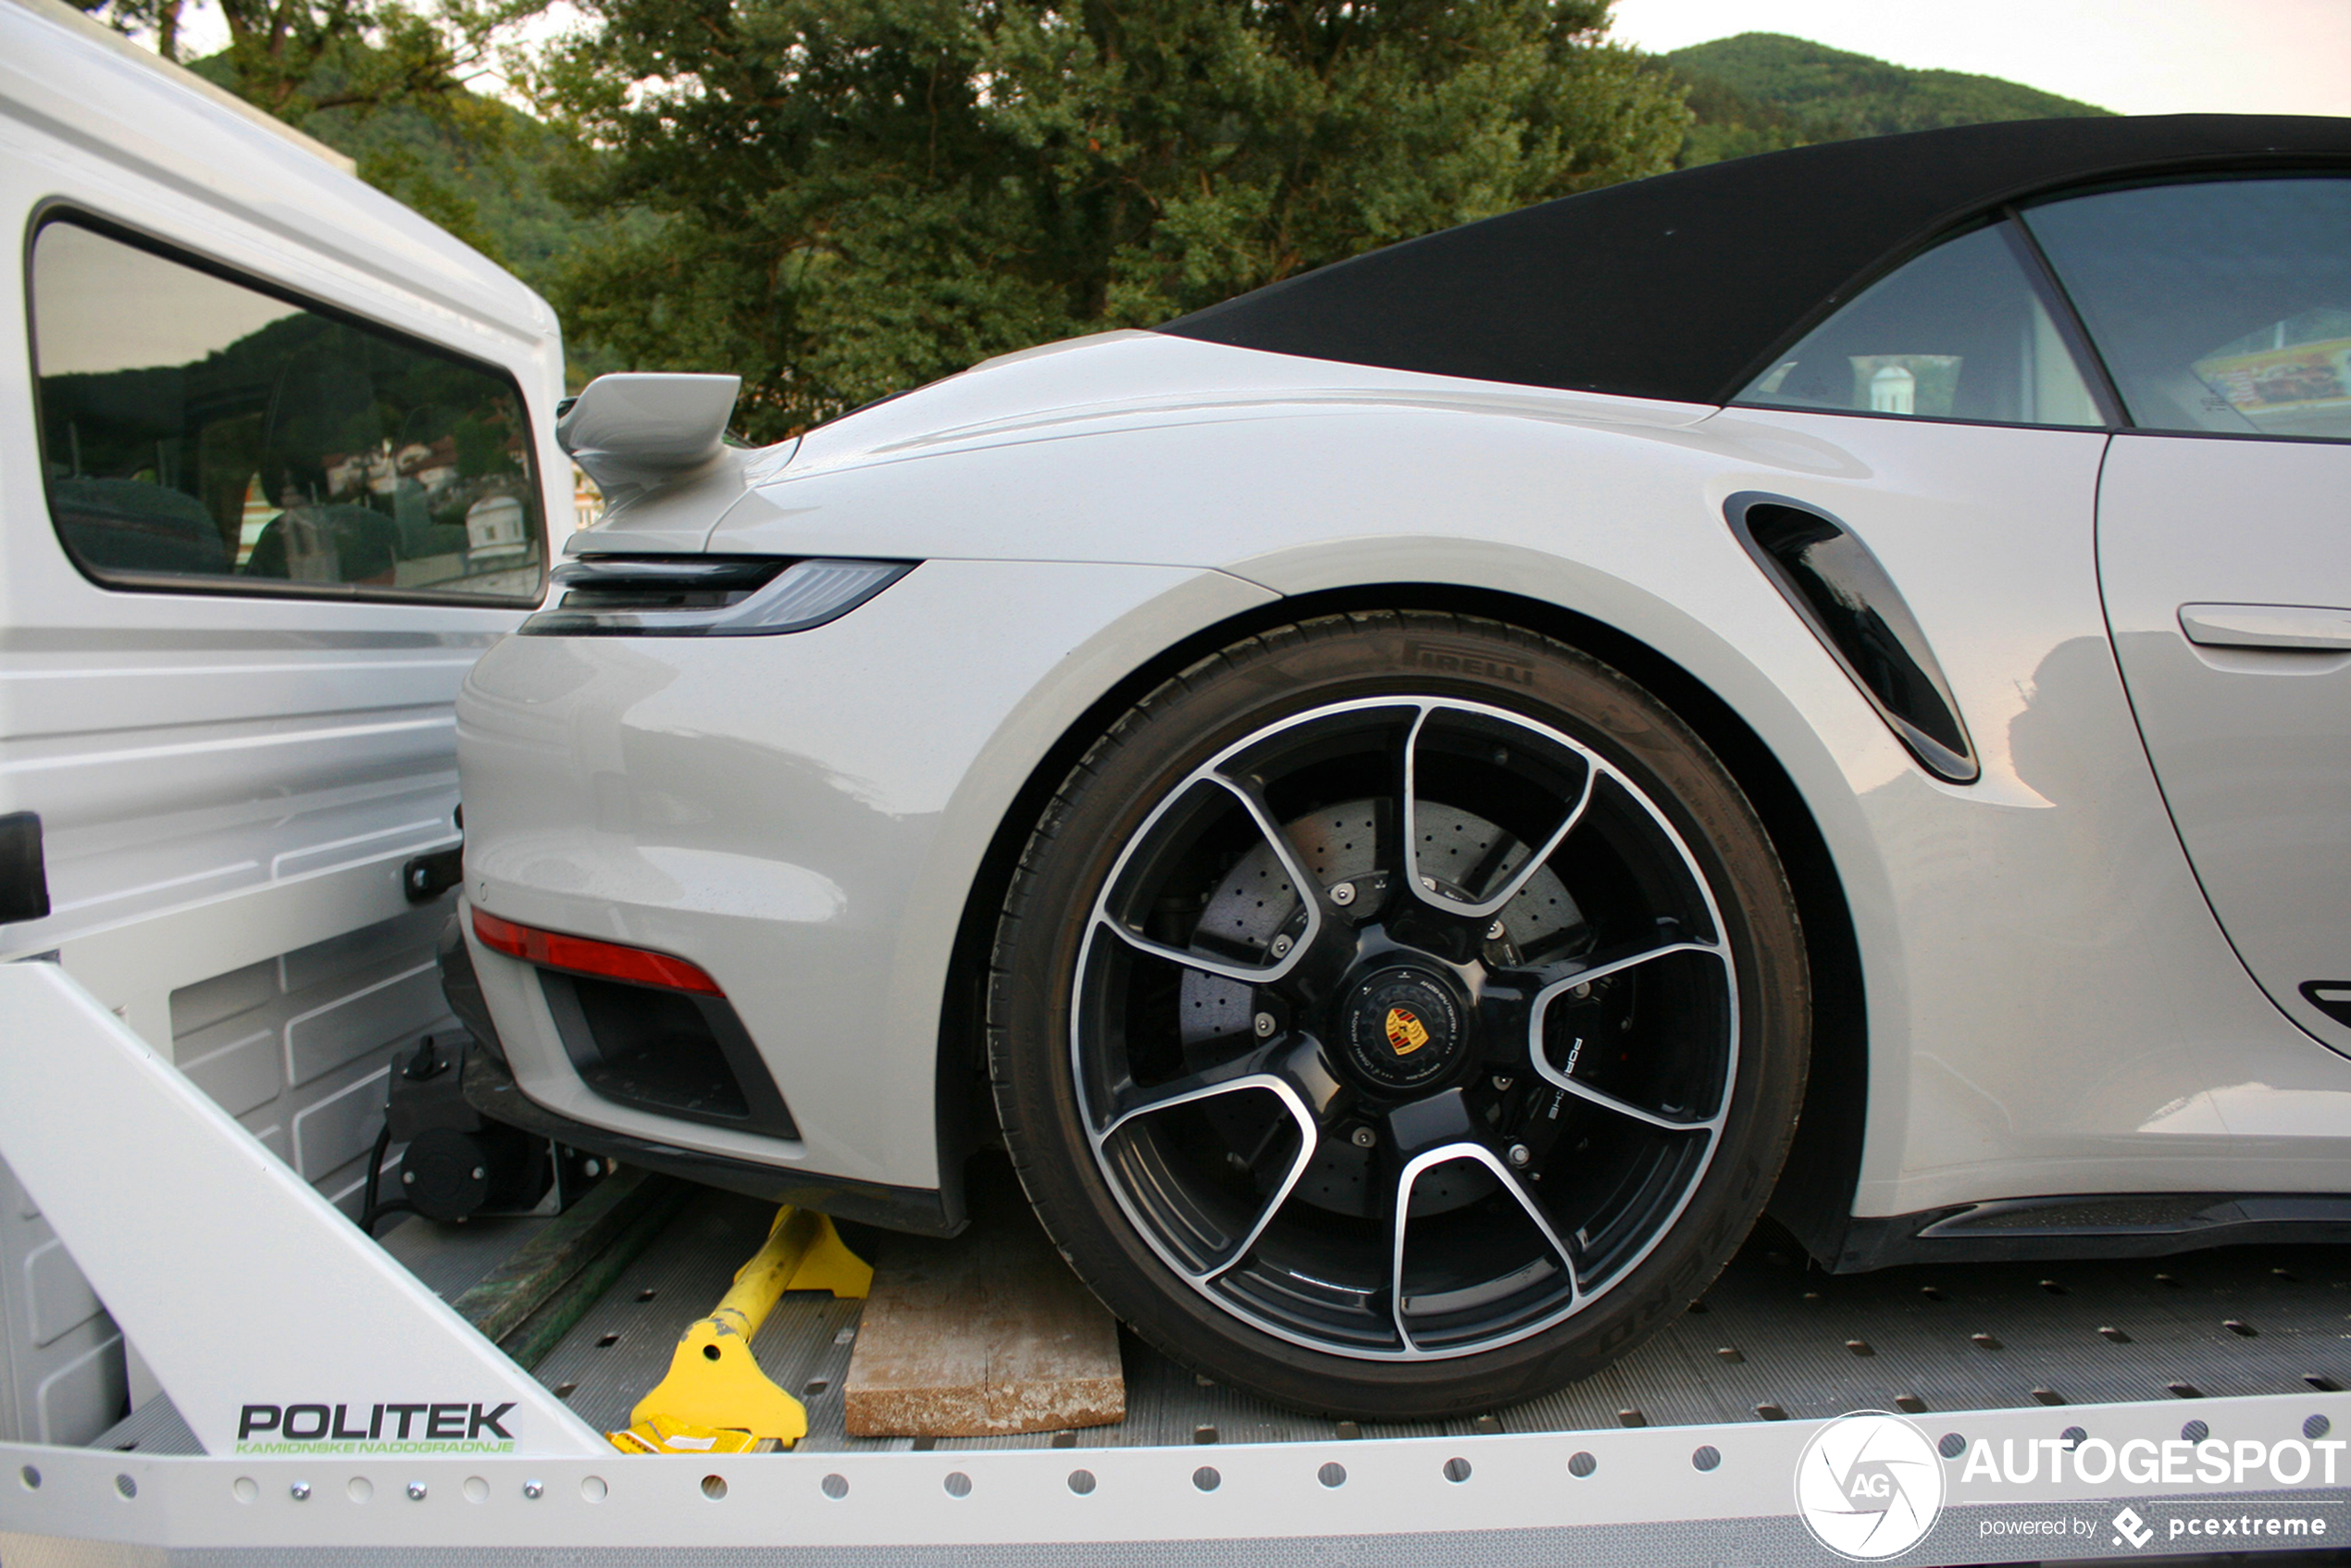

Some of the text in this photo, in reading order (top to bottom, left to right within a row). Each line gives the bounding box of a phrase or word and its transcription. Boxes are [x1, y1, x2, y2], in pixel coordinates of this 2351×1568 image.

[1403, 639, 1536, 687] PIRELLI
[237, 1401, 518, 1440] POLITEK
[235, 1440, 516, 1454] KAMIONSKE NADOGRADNJE
